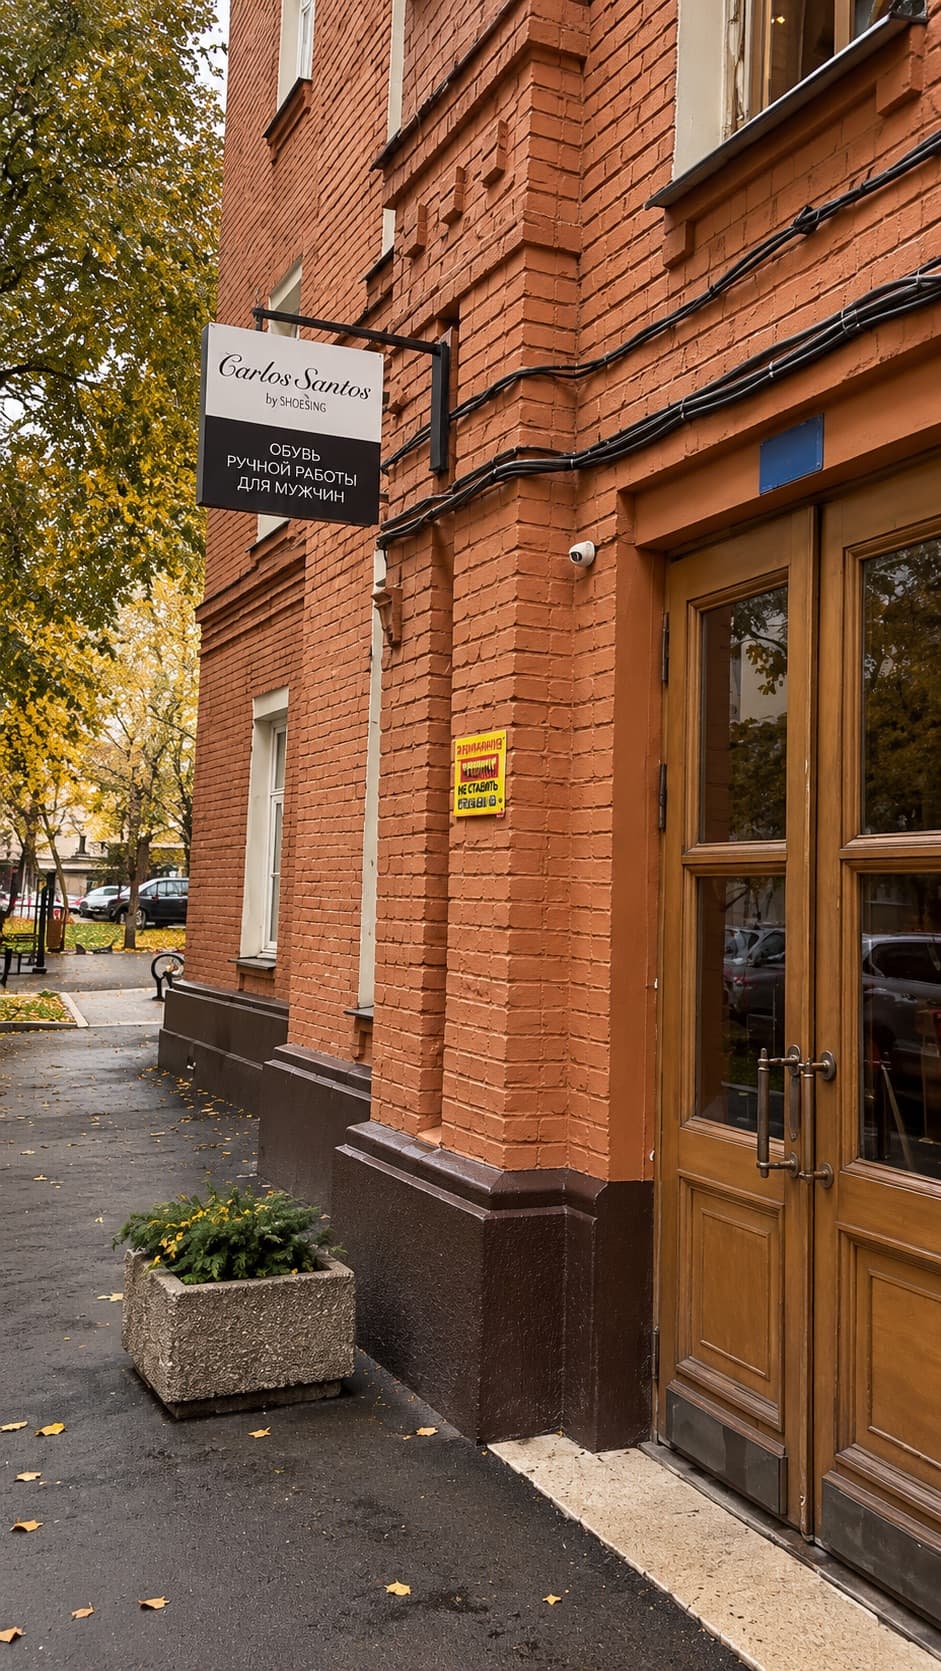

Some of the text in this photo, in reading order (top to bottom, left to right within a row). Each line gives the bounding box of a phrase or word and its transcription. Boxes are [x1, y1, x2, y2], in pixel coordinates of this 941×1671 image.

[219, 353, 372, 400] Carlos Santos
[266, 393, 327, 413] by SHOESING
[270, 443, 321, 461] ОБУВЬ
[227, 456, 357, 486] РУЧНОЙ РАБОТЫ
[237, 477, 345, 503] ДЛЯ МУЖЧИН
[458, 784, 466, 795] НЕ
